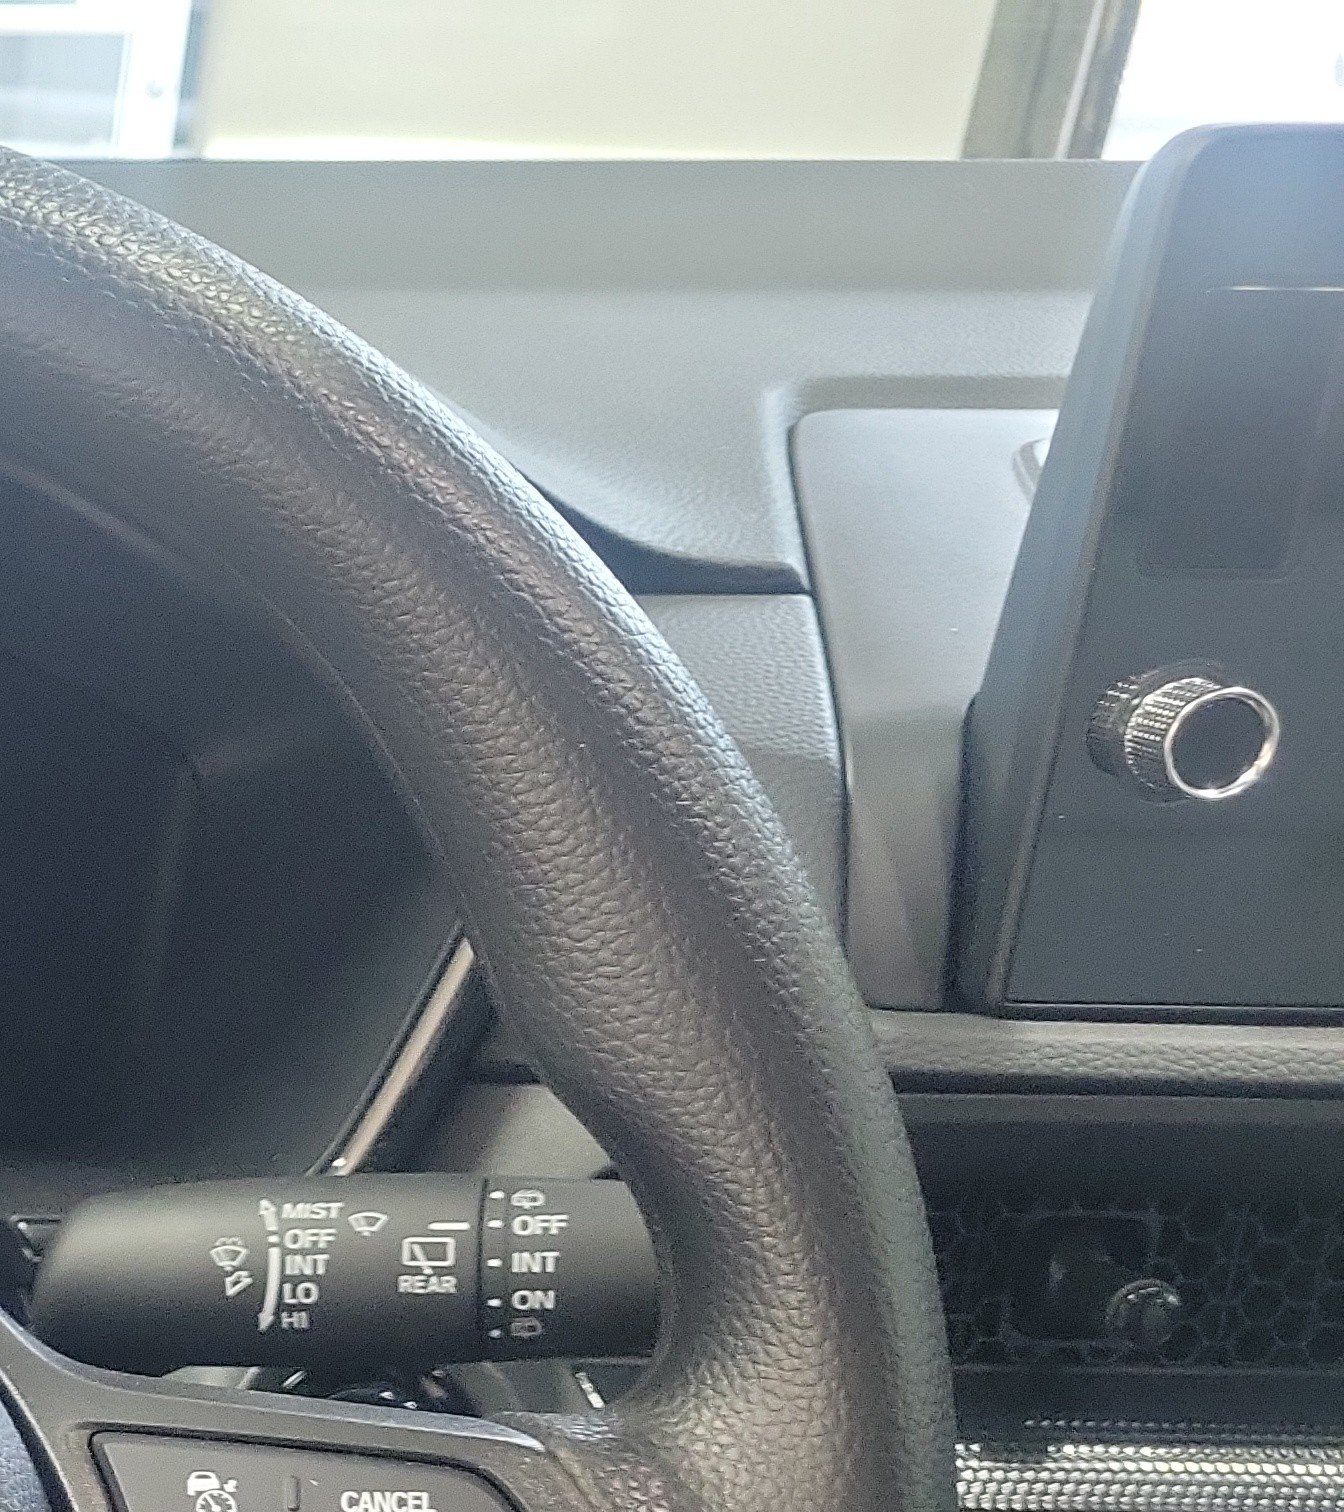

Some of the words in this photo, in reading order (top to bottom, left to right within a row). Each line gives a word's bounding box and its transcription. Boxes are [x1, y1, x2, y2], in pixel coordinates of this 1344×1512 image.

[281, 1202, 345, 1219] MIST
[512, 1214, 569, 1236] OFF
[283, 1229, 337, 1249] OFF
[284, 1254, 330, 1276] INT
[511, 1251, 560, 1273] INT
[282, 1282, 320, 1304] LO
[397, 1275, 458, 1294] REAR
[512, 1290, 555, 1310] ON
[280, 1310, 311, 1330] HI
